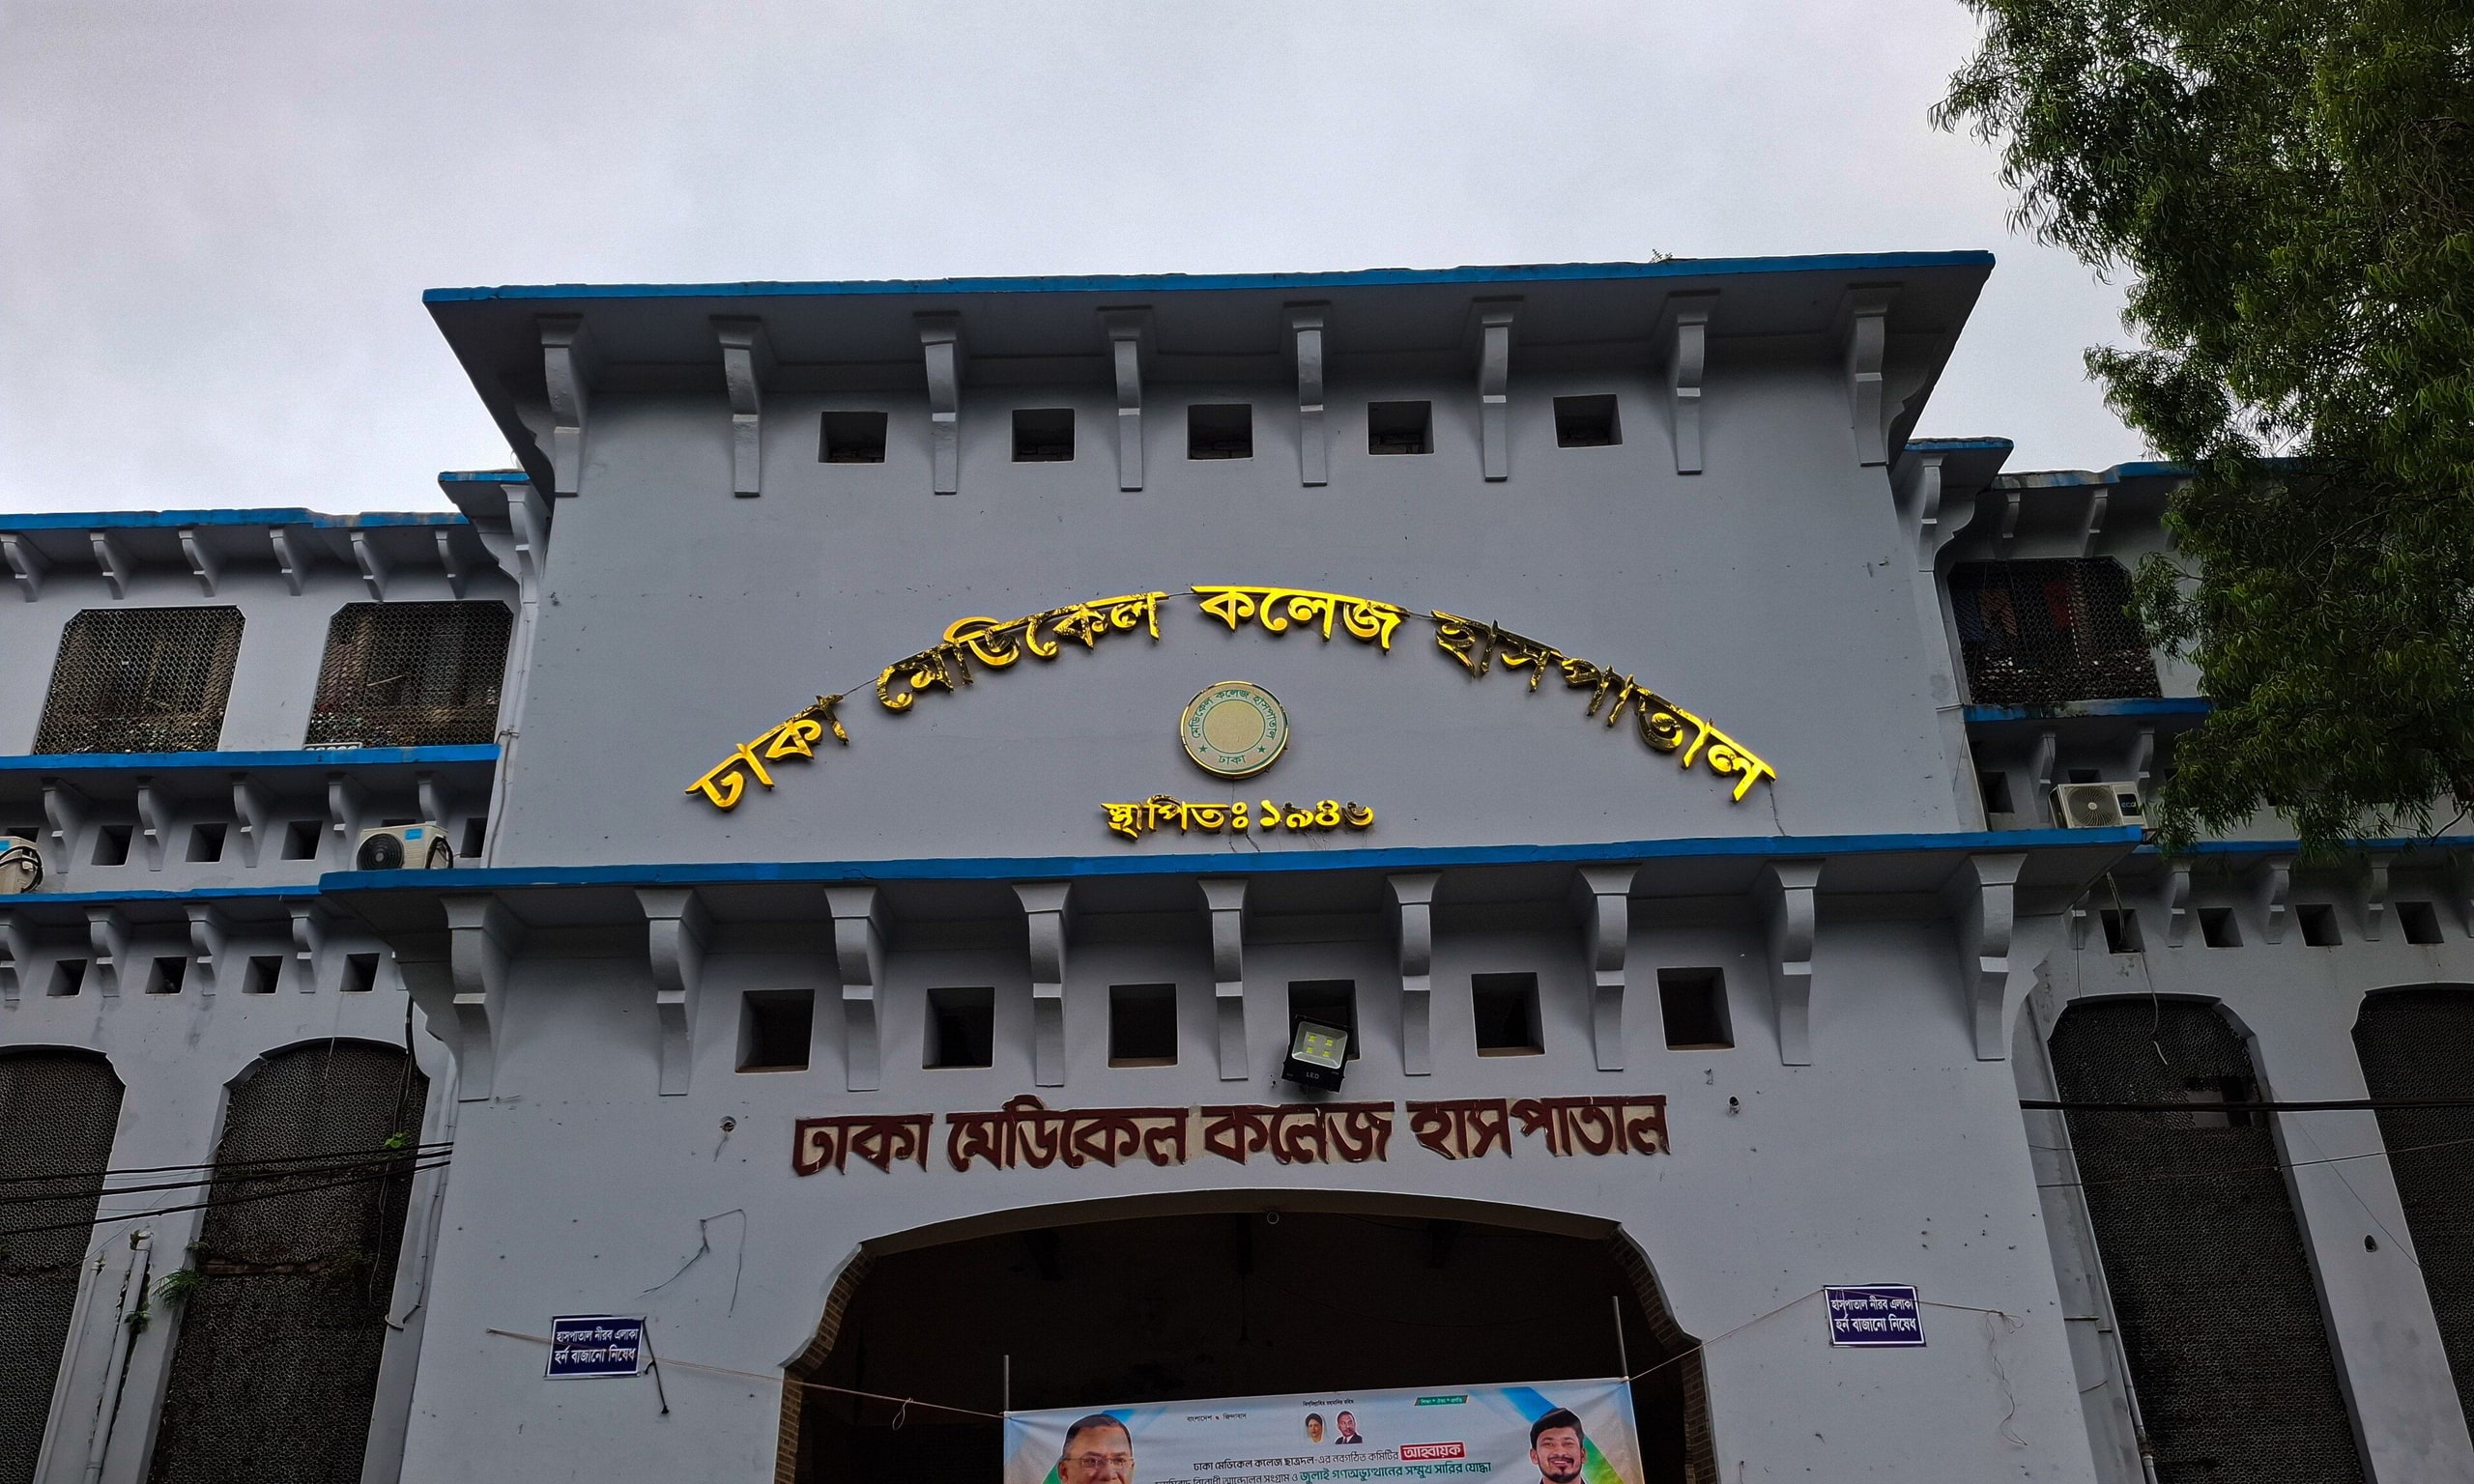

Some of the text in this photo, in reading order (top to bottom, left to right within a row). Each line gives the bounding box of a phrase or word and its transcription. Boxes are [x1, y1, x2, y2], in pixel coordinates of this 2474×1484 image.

[684, 585, 1776, 812] ঢাকা মেডিকেল কলেজ হাসপাতাল
[1189, 689, 1278, 740] মেডিকেল কলেজ হাসপাতাল
[1219, 755, 1247, 765] ঢাকা
[1259, 799, 1374, 832] ১৯৪৬
[1306, 1070, 1320, 1080] LED
[792, 1094, 1671, 1177] ঢাকা মেডিকেল কলেজ হাসপাতাল
[1830, 1295, 1913, 1311] হাসপাতাল নীরব এলাকা
[1833, 1313, 1917, 1332] হর্ন বাজানো নিষেধ
[556, 1326, 639, 1342] হাসপাতাল নীরব এলাকা
[554, 1343, 637, 1364] হর্ন বাজানো নিষেধ
[1194, 1461, 1214, 1471] ঢাকা
[1215, 1458, 1252, 1470] মেডিকেল
[1254, 1457, 1282, 1468] কলেজ
[1333, 1451, 1366, 1464] নবগঠিত
[1368, 1449, 1398, 1461] কমিটির
[1263, 1473, 1290, 1484] সংগ্রাম
[1292, 1473, 1299, 1482] ও
[1300, 1468, 1331, 1484] জুলাই
[1405, 1464, 1432, 1478] সম্মুখ
[1435, 1460, 1463, 1473] সারির
[1465, 1462, 1491, 1473] যোদ্ধা
